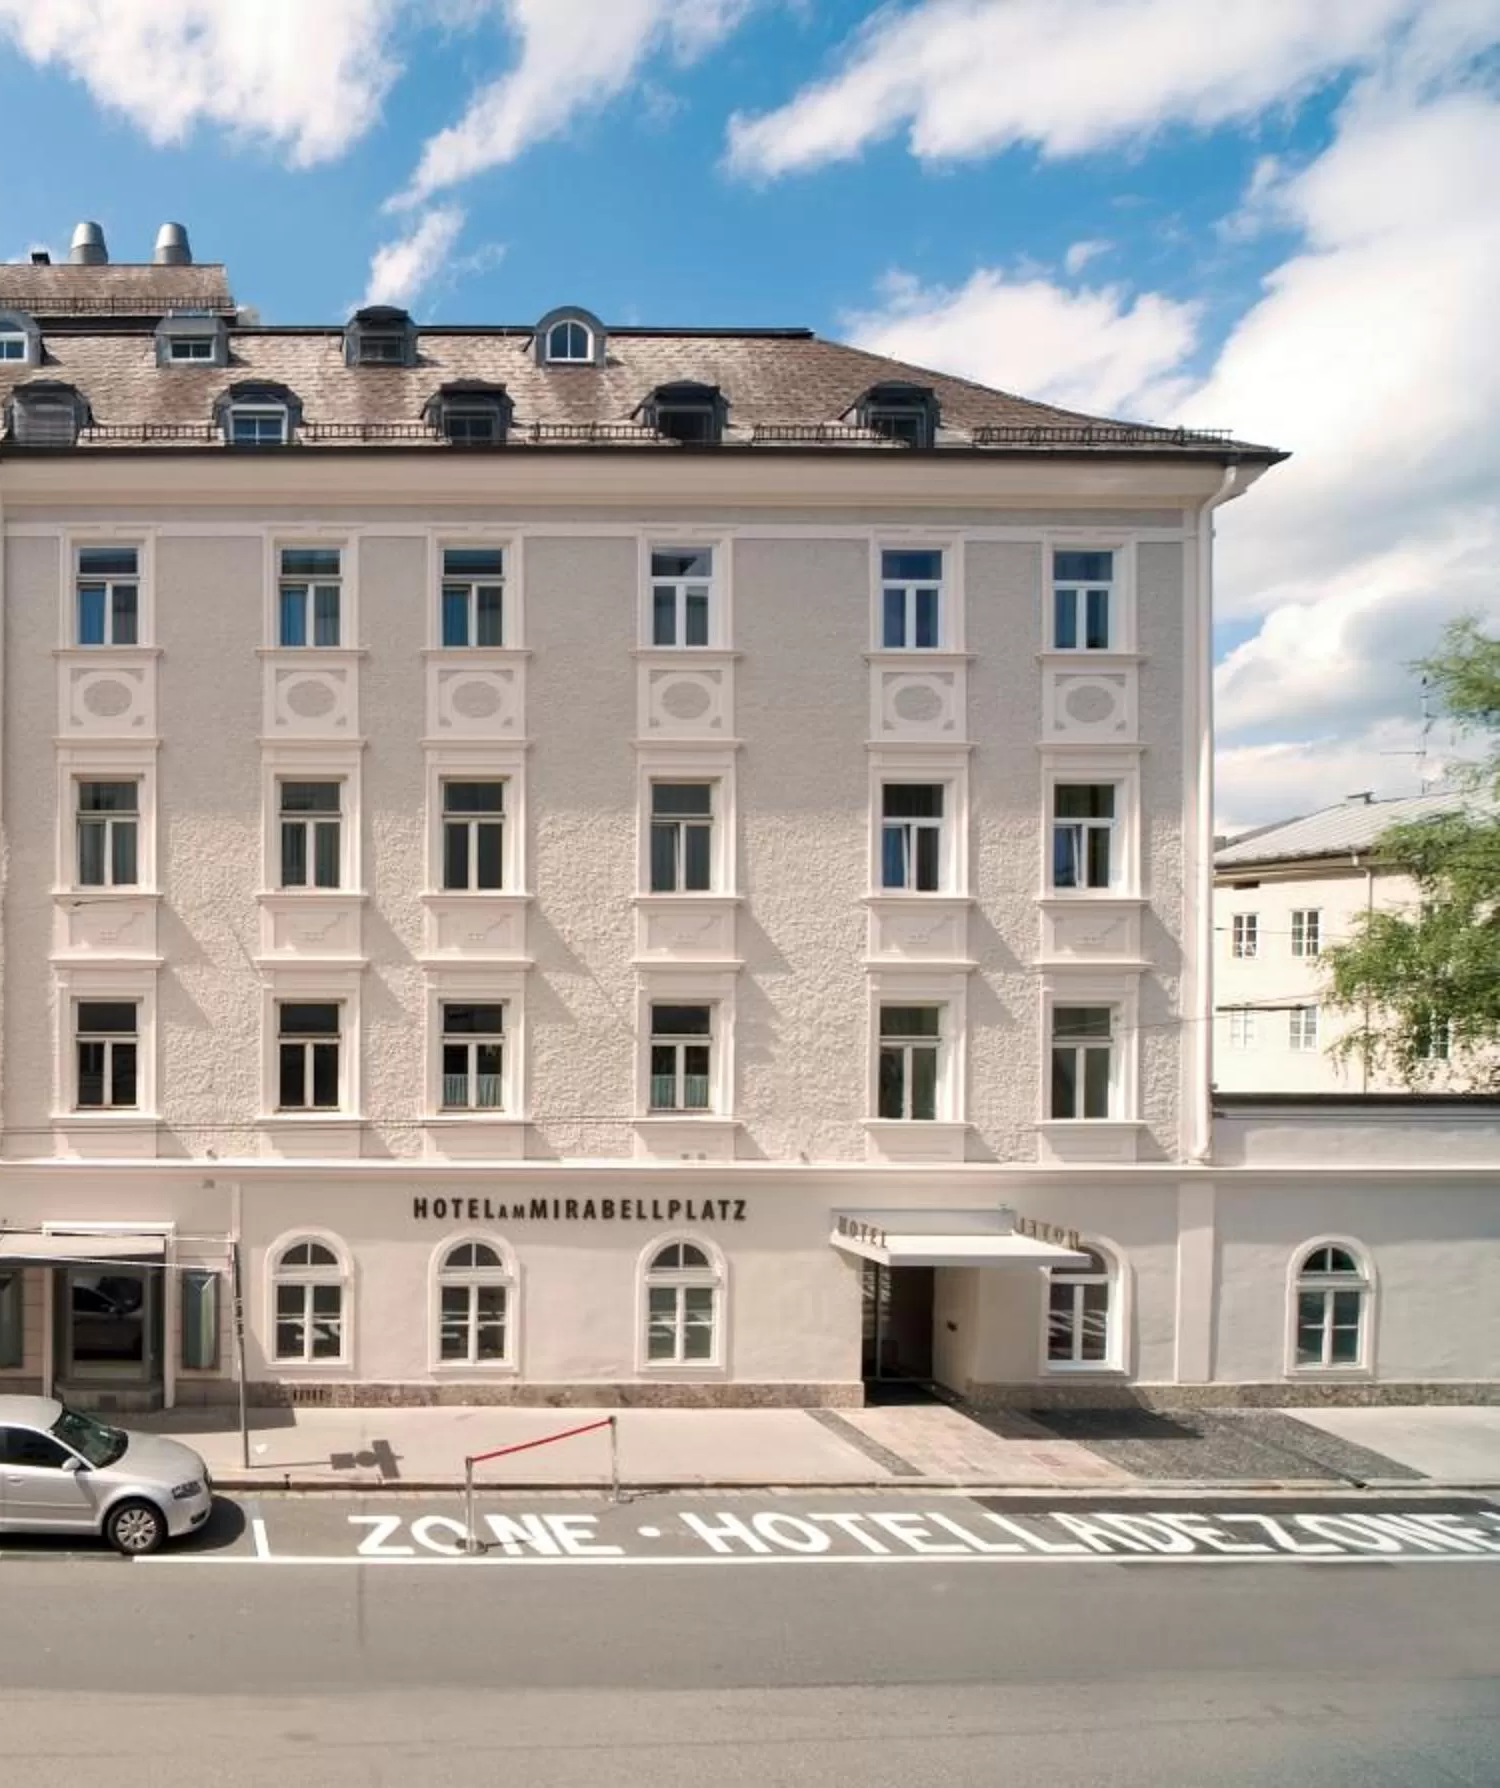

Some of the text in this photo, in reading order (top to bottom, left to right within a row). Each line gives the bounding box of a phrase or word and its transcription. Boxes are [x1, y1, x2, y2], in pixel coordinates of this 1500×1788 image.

[413, 1197, 747, 1221] HOTEL AM MIRABELLPLATZ
[838, 1215, 888, 1249] HOTEL
[347, 1513, 626, 1555] ZONE
